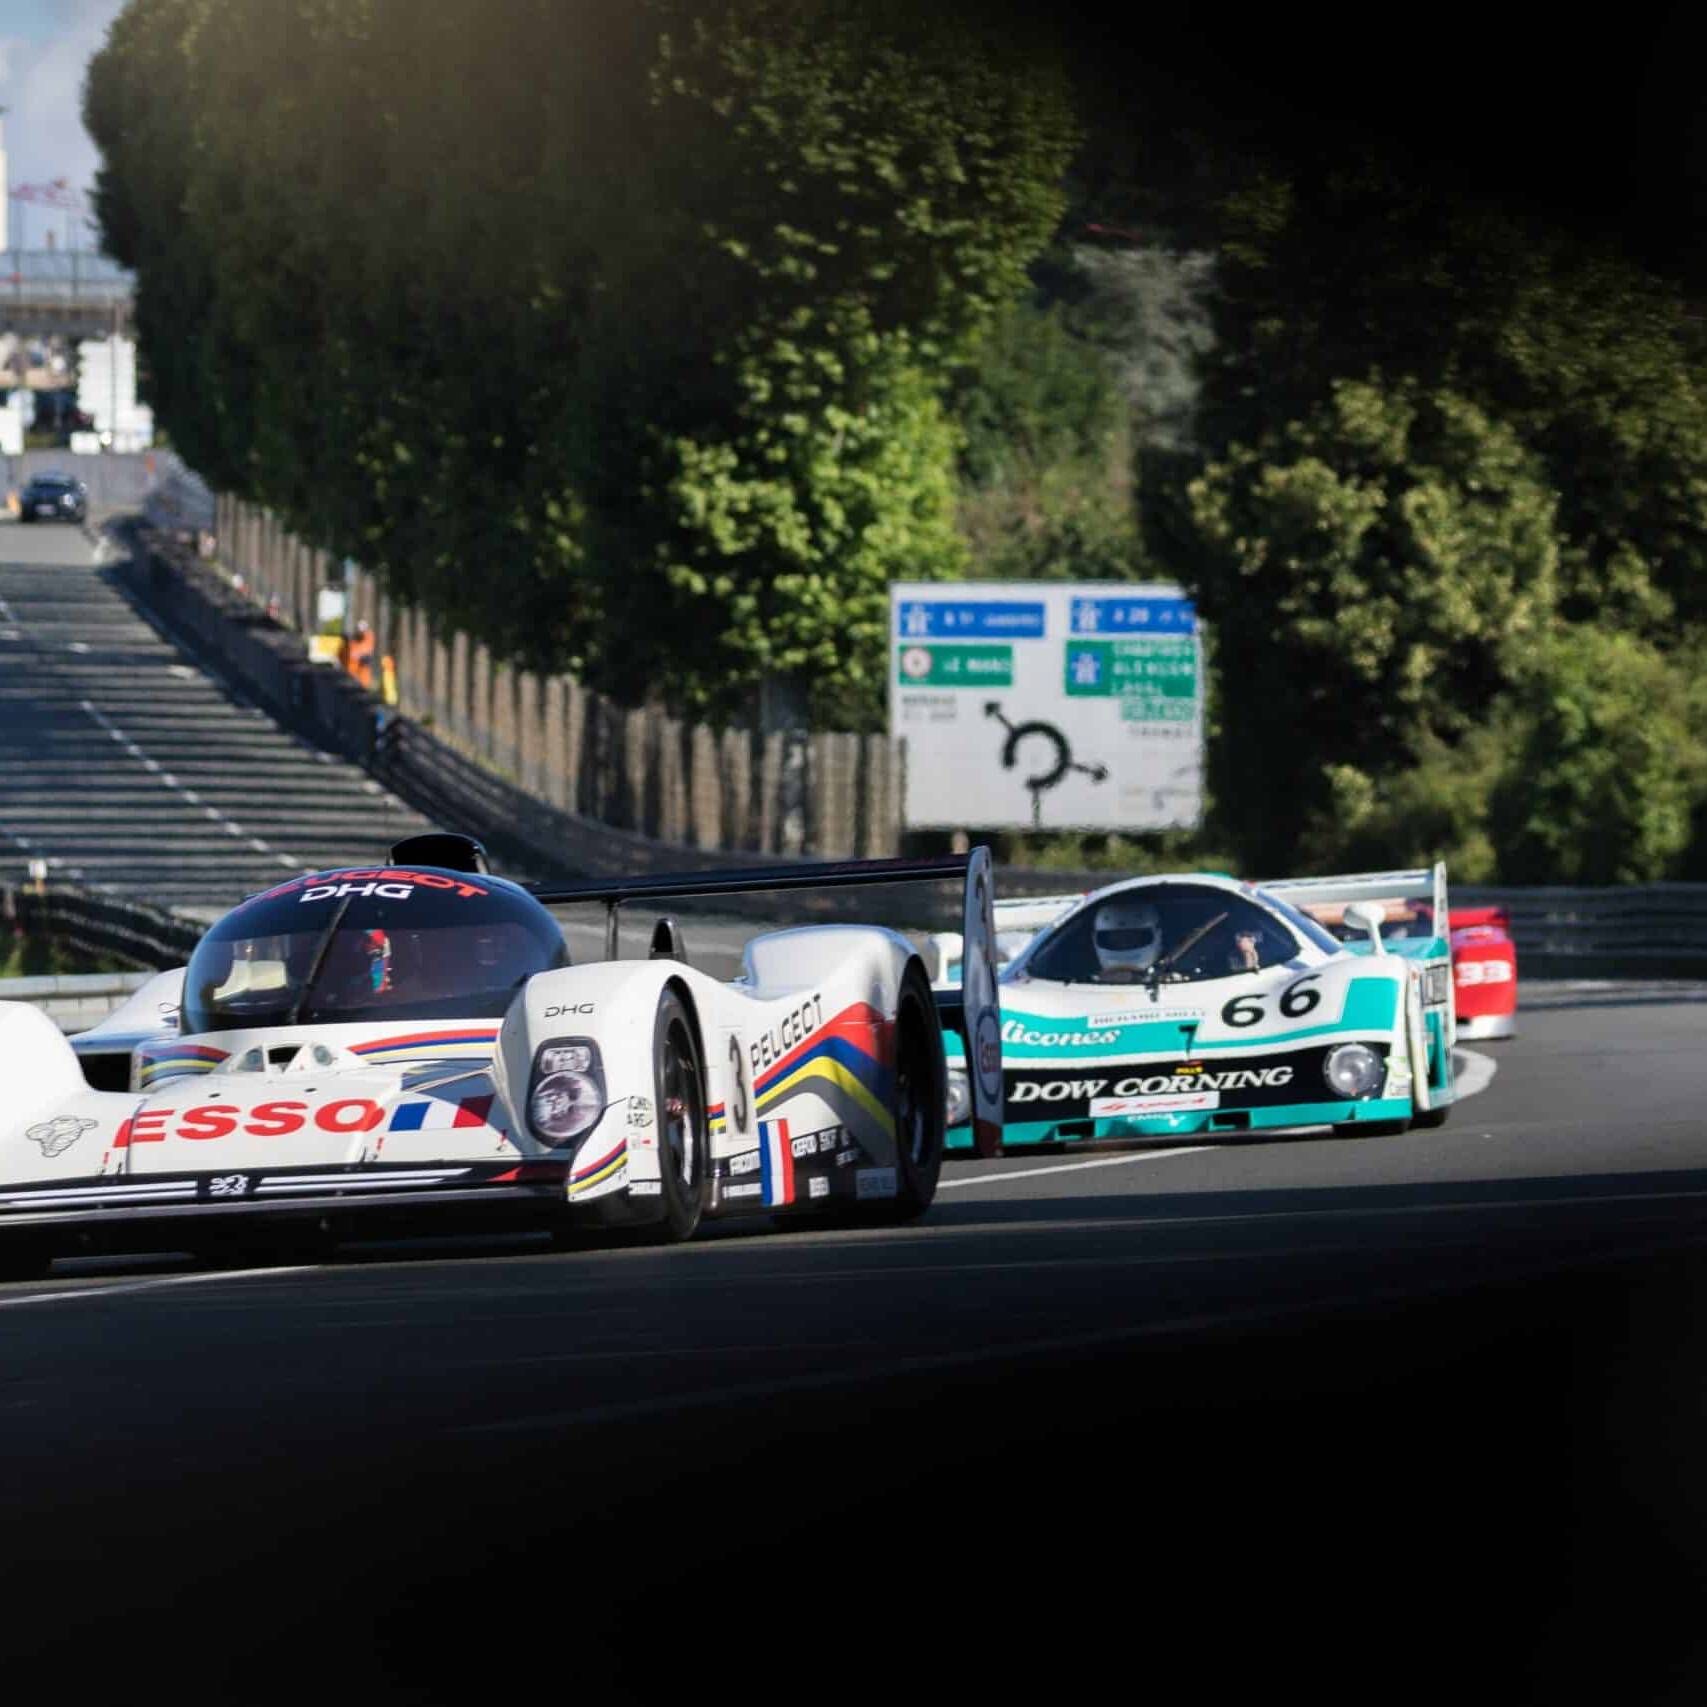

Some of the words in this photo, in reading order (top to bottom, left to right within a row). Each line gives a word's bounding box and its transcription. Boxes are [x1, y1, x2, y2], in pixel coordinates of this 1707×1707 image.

[299, 882, 415, 904] DHG
[1456, 959, 1512, 987] 33
[544, 1003, 595, 1018] DHG
[1221, 974, 1323, 1028] 66
[750, 994, 823, 1076] PEUGEOT
[1001, 1020, 1121, 1047] licones
[730, 1034, 748, 1134] 3
[1008, 1080, 1108, 1102] DOW
[1113, 1066, 1294, 1097] CORNING
[112, 1098, 387, 1148] ESSO
